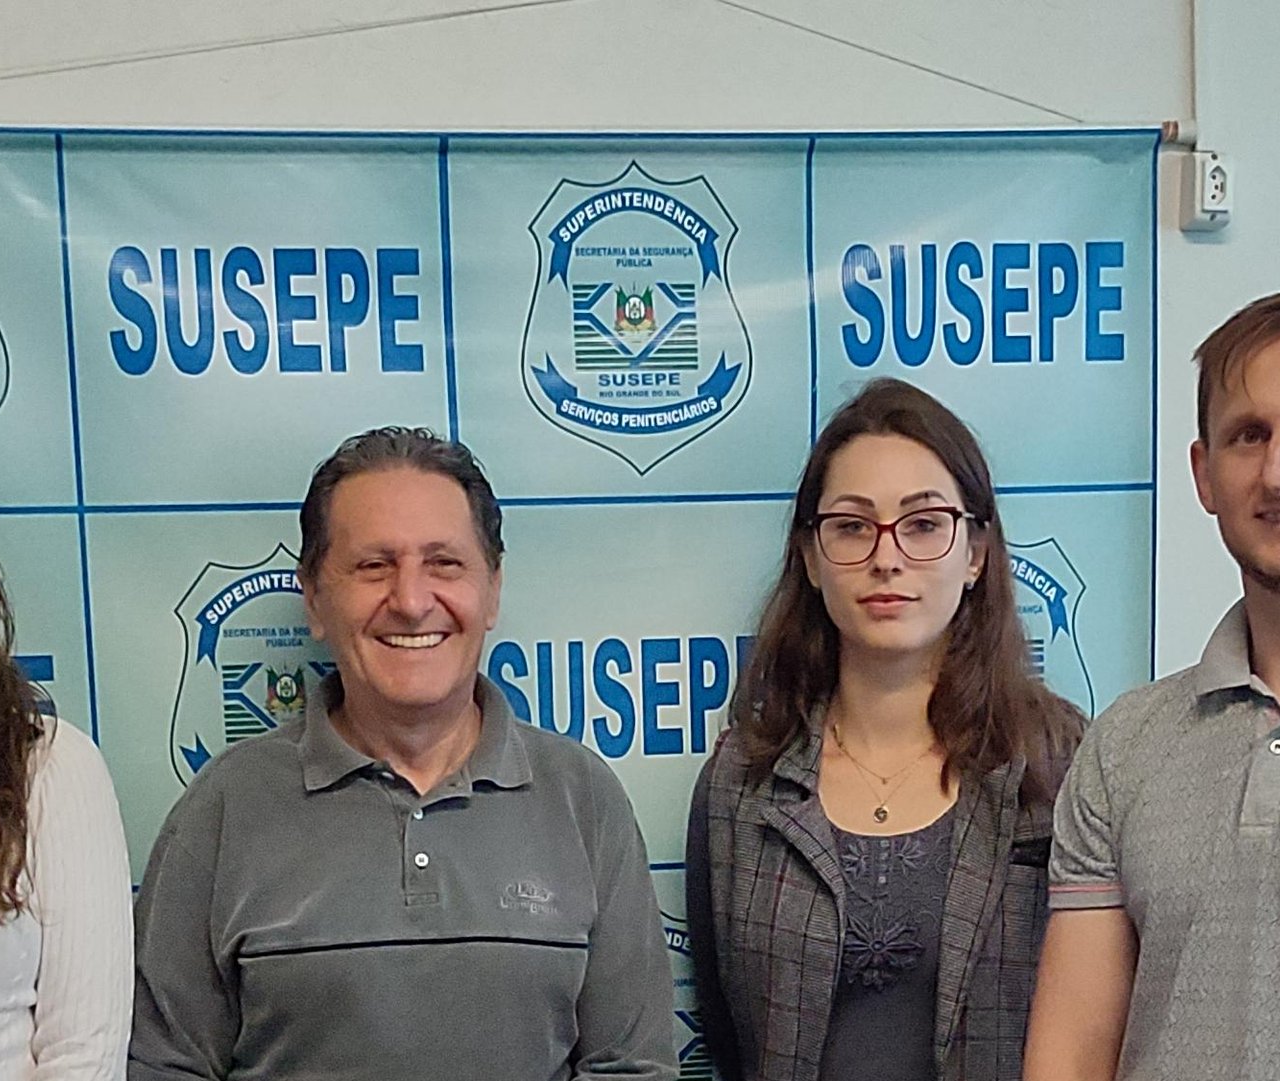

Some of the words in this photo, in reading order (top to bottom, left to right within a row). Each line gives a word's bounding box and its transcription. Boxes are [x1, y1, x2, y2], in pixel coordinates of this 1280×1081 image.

[559, 192, 707, 244] SUPERINTENDÊNCIA
[575, 247, 627, 257] SECRETARIA
[629, 247, 641, 257] DA
[642, 247, 694, 258] SEGURANÇA
[616, 257, 652, 268] PÚBLICA
[108, 247, 424, 376] SUSEPE
[841, 241, 1124, 367] SUSEPE
[598, 373, 680, 386] SUSEPE
[560, 399, 619, 426] SERVIÇOS
[621, 396, 718, 428] PENITENCIÁRIOS
[206, 573, 302, 625] SUPERINTEN
